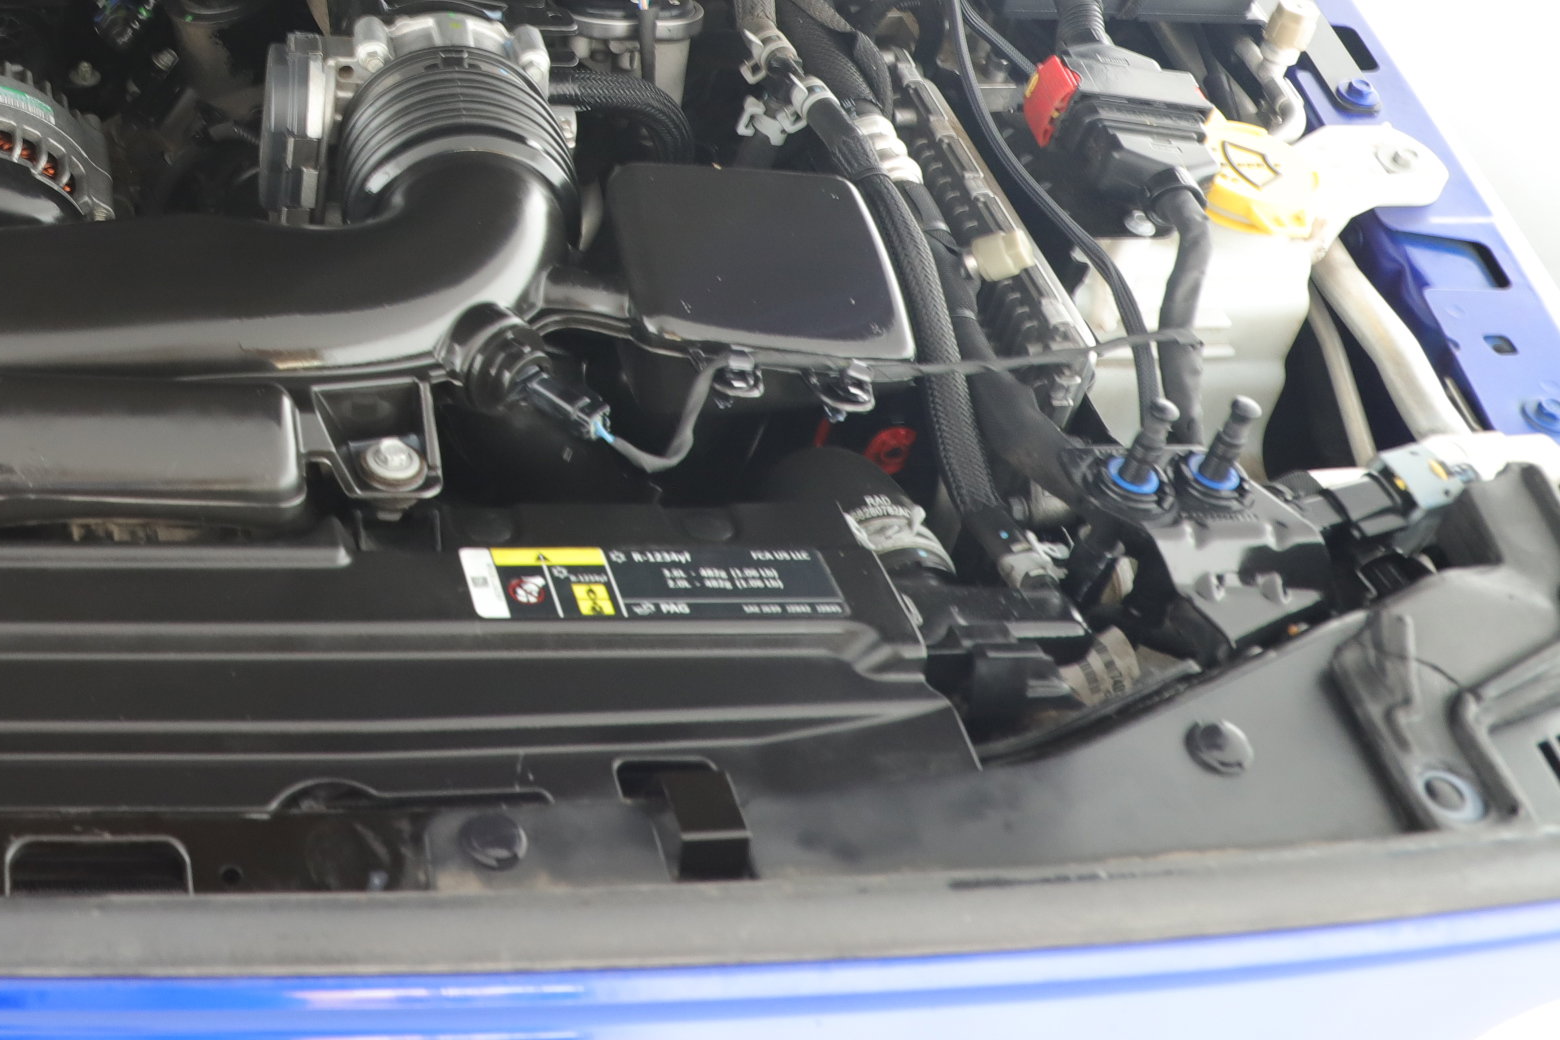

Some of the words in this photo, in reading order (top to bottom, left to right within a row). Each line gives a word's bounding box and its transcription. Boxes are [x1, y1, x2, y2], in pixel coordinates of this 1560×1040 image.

[863, 494, 893, 508] RAD
[750, 550, 773, 561] FCA
[659, 602, 690, 614] PAG
